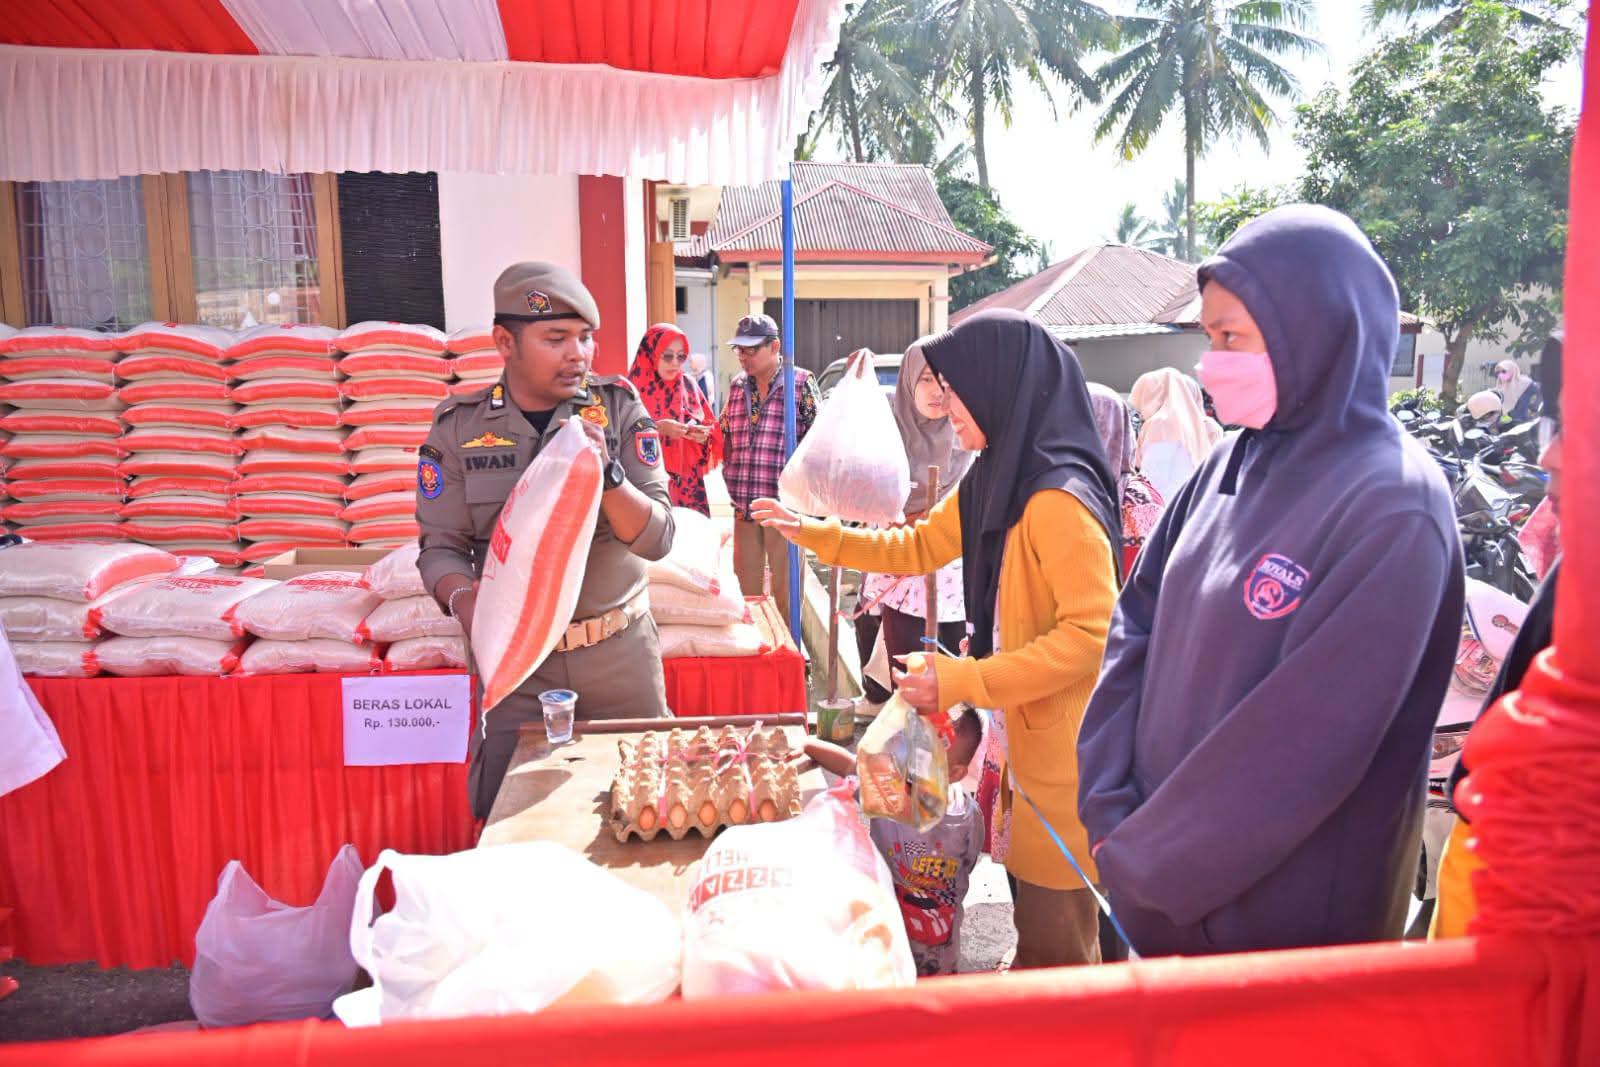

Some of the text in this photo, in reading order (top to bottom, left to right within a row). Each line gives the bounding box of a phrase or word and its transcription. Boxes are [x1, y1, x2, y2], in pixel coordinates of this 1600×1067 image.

[465, 454, 515, 470] IWAN
[1259, 559, 1305, 588] ROYALS
[353, 698, 452, 710] BERAS LOKAL
[364, 717, 440, 731] Rp. 130.000,-
